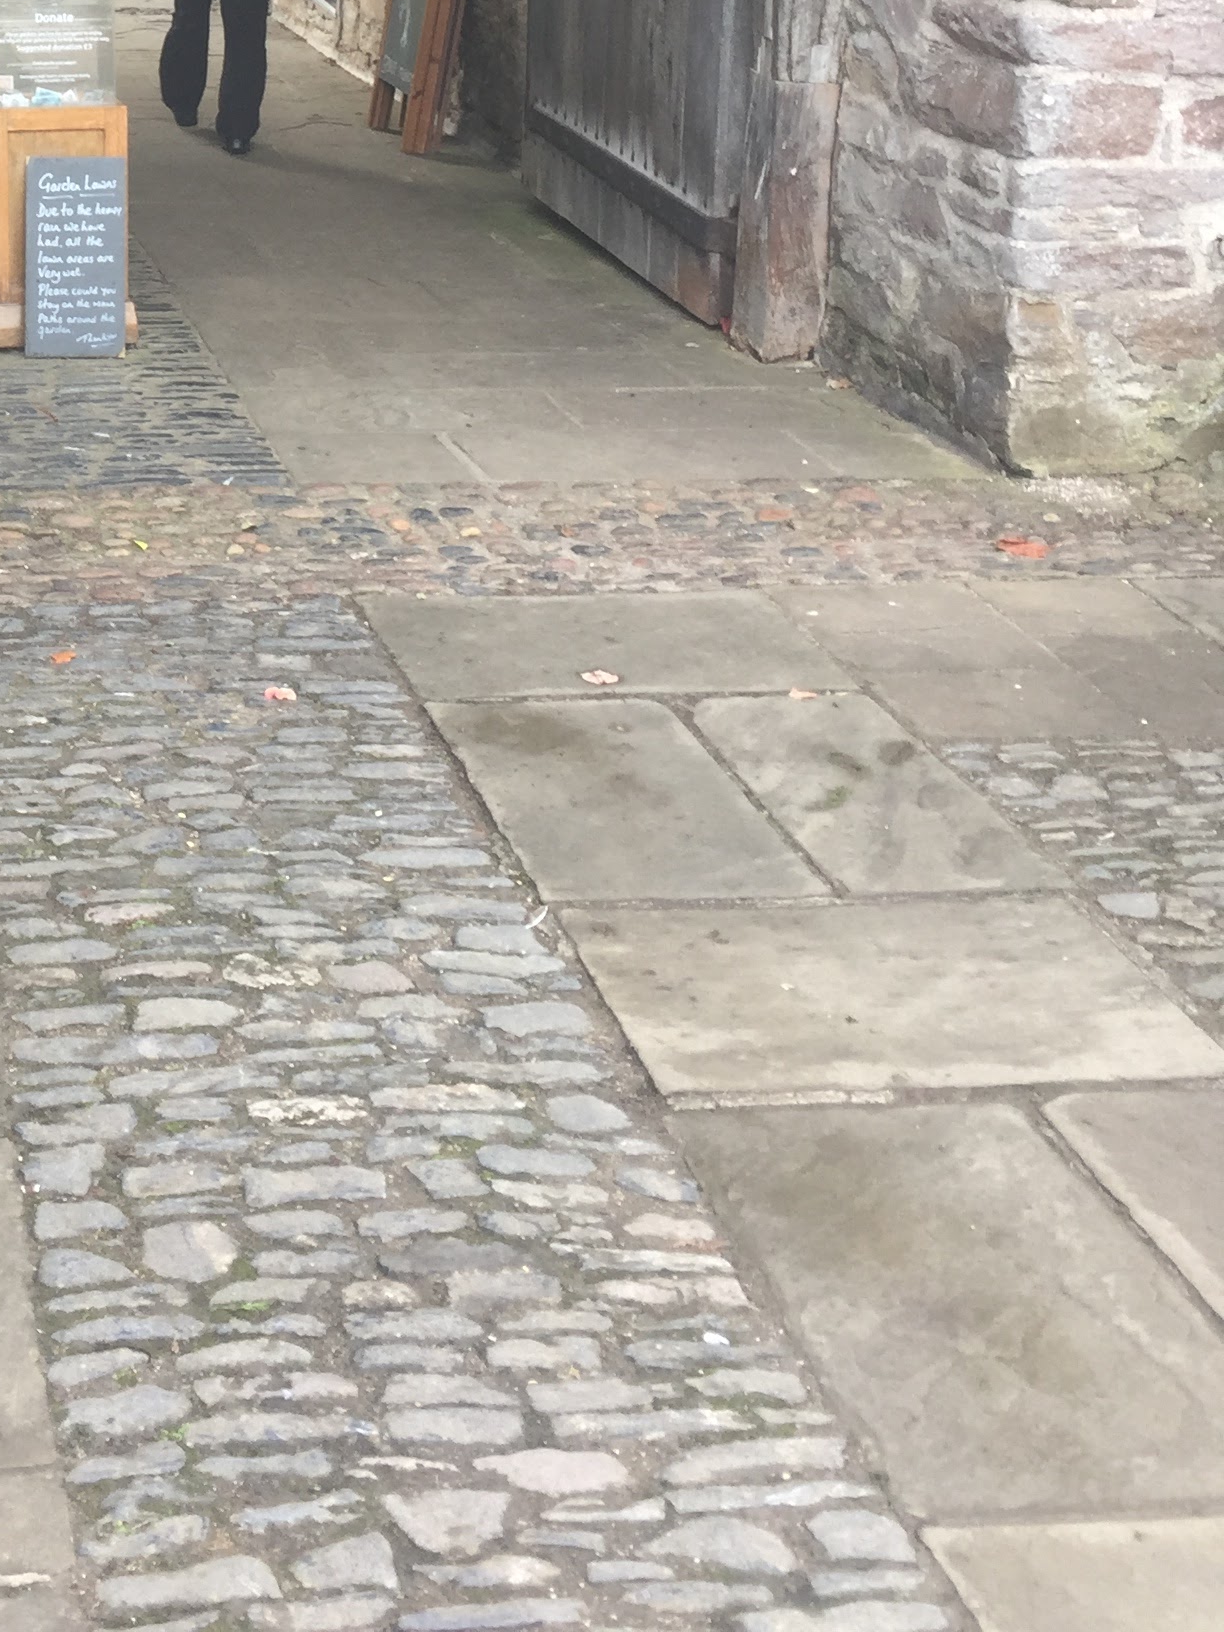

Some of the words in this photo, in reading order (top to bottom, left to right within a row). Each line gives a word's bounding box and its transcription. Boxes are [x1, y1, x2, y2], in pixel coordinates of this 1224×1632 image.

[34, 12, 75, 23] Donate
[38, 172, 81, 193] Garden
[36, 202, 59, 218] Due
[60, 202, 74, 217] to
[76, 203, 93, 216] the
[94, 202, 123, 216] heavy
[63, 222, 80, 232] we
[81, 220, 106, 232] have
[65, 236, 82, 247] all
[86, 235, 104, 247] the
[66, 255, 94, 264] areas
[96, 255, 114, 263] are
[37, 265, 61, 284] Very
[38, 283, 70, 296] Please
[71, 286, 98, 296] could
[100, 287, 117, 297] you
[37, 298, 60, 315] stay
[76, 299, 91, 308] the
[66, 316, 97, 324] around
[100, 313, 116, 323] the
